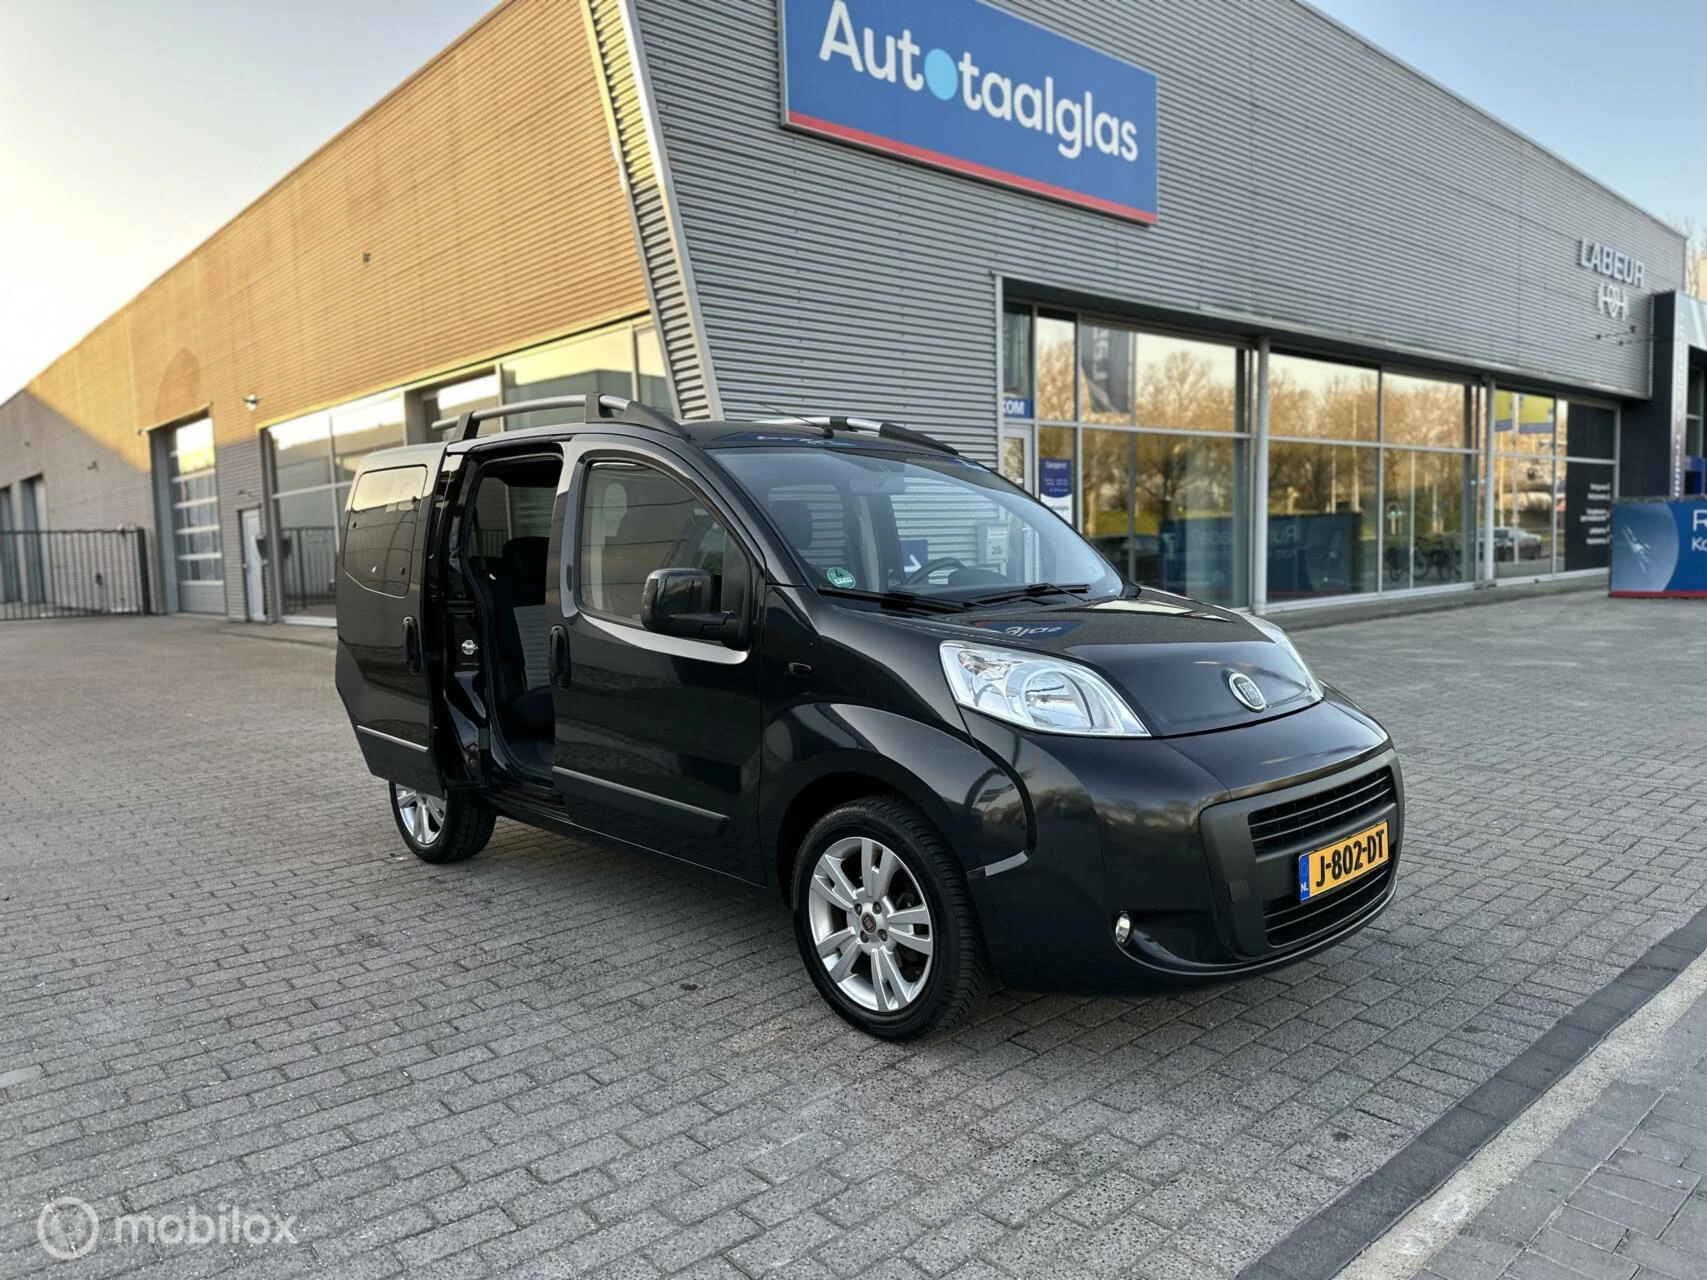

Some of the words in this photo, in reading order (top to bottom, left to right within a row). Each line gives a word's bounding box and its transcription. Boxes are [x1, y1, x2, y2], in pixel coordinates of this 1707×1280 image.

[819, 0, 1138, 161] Autotaalglas
[1580, 238, 1645, 287] LABEUR
[1316, 829, 1385, 887] J-802-DT
[1300, 882, 1309, 893] NL
